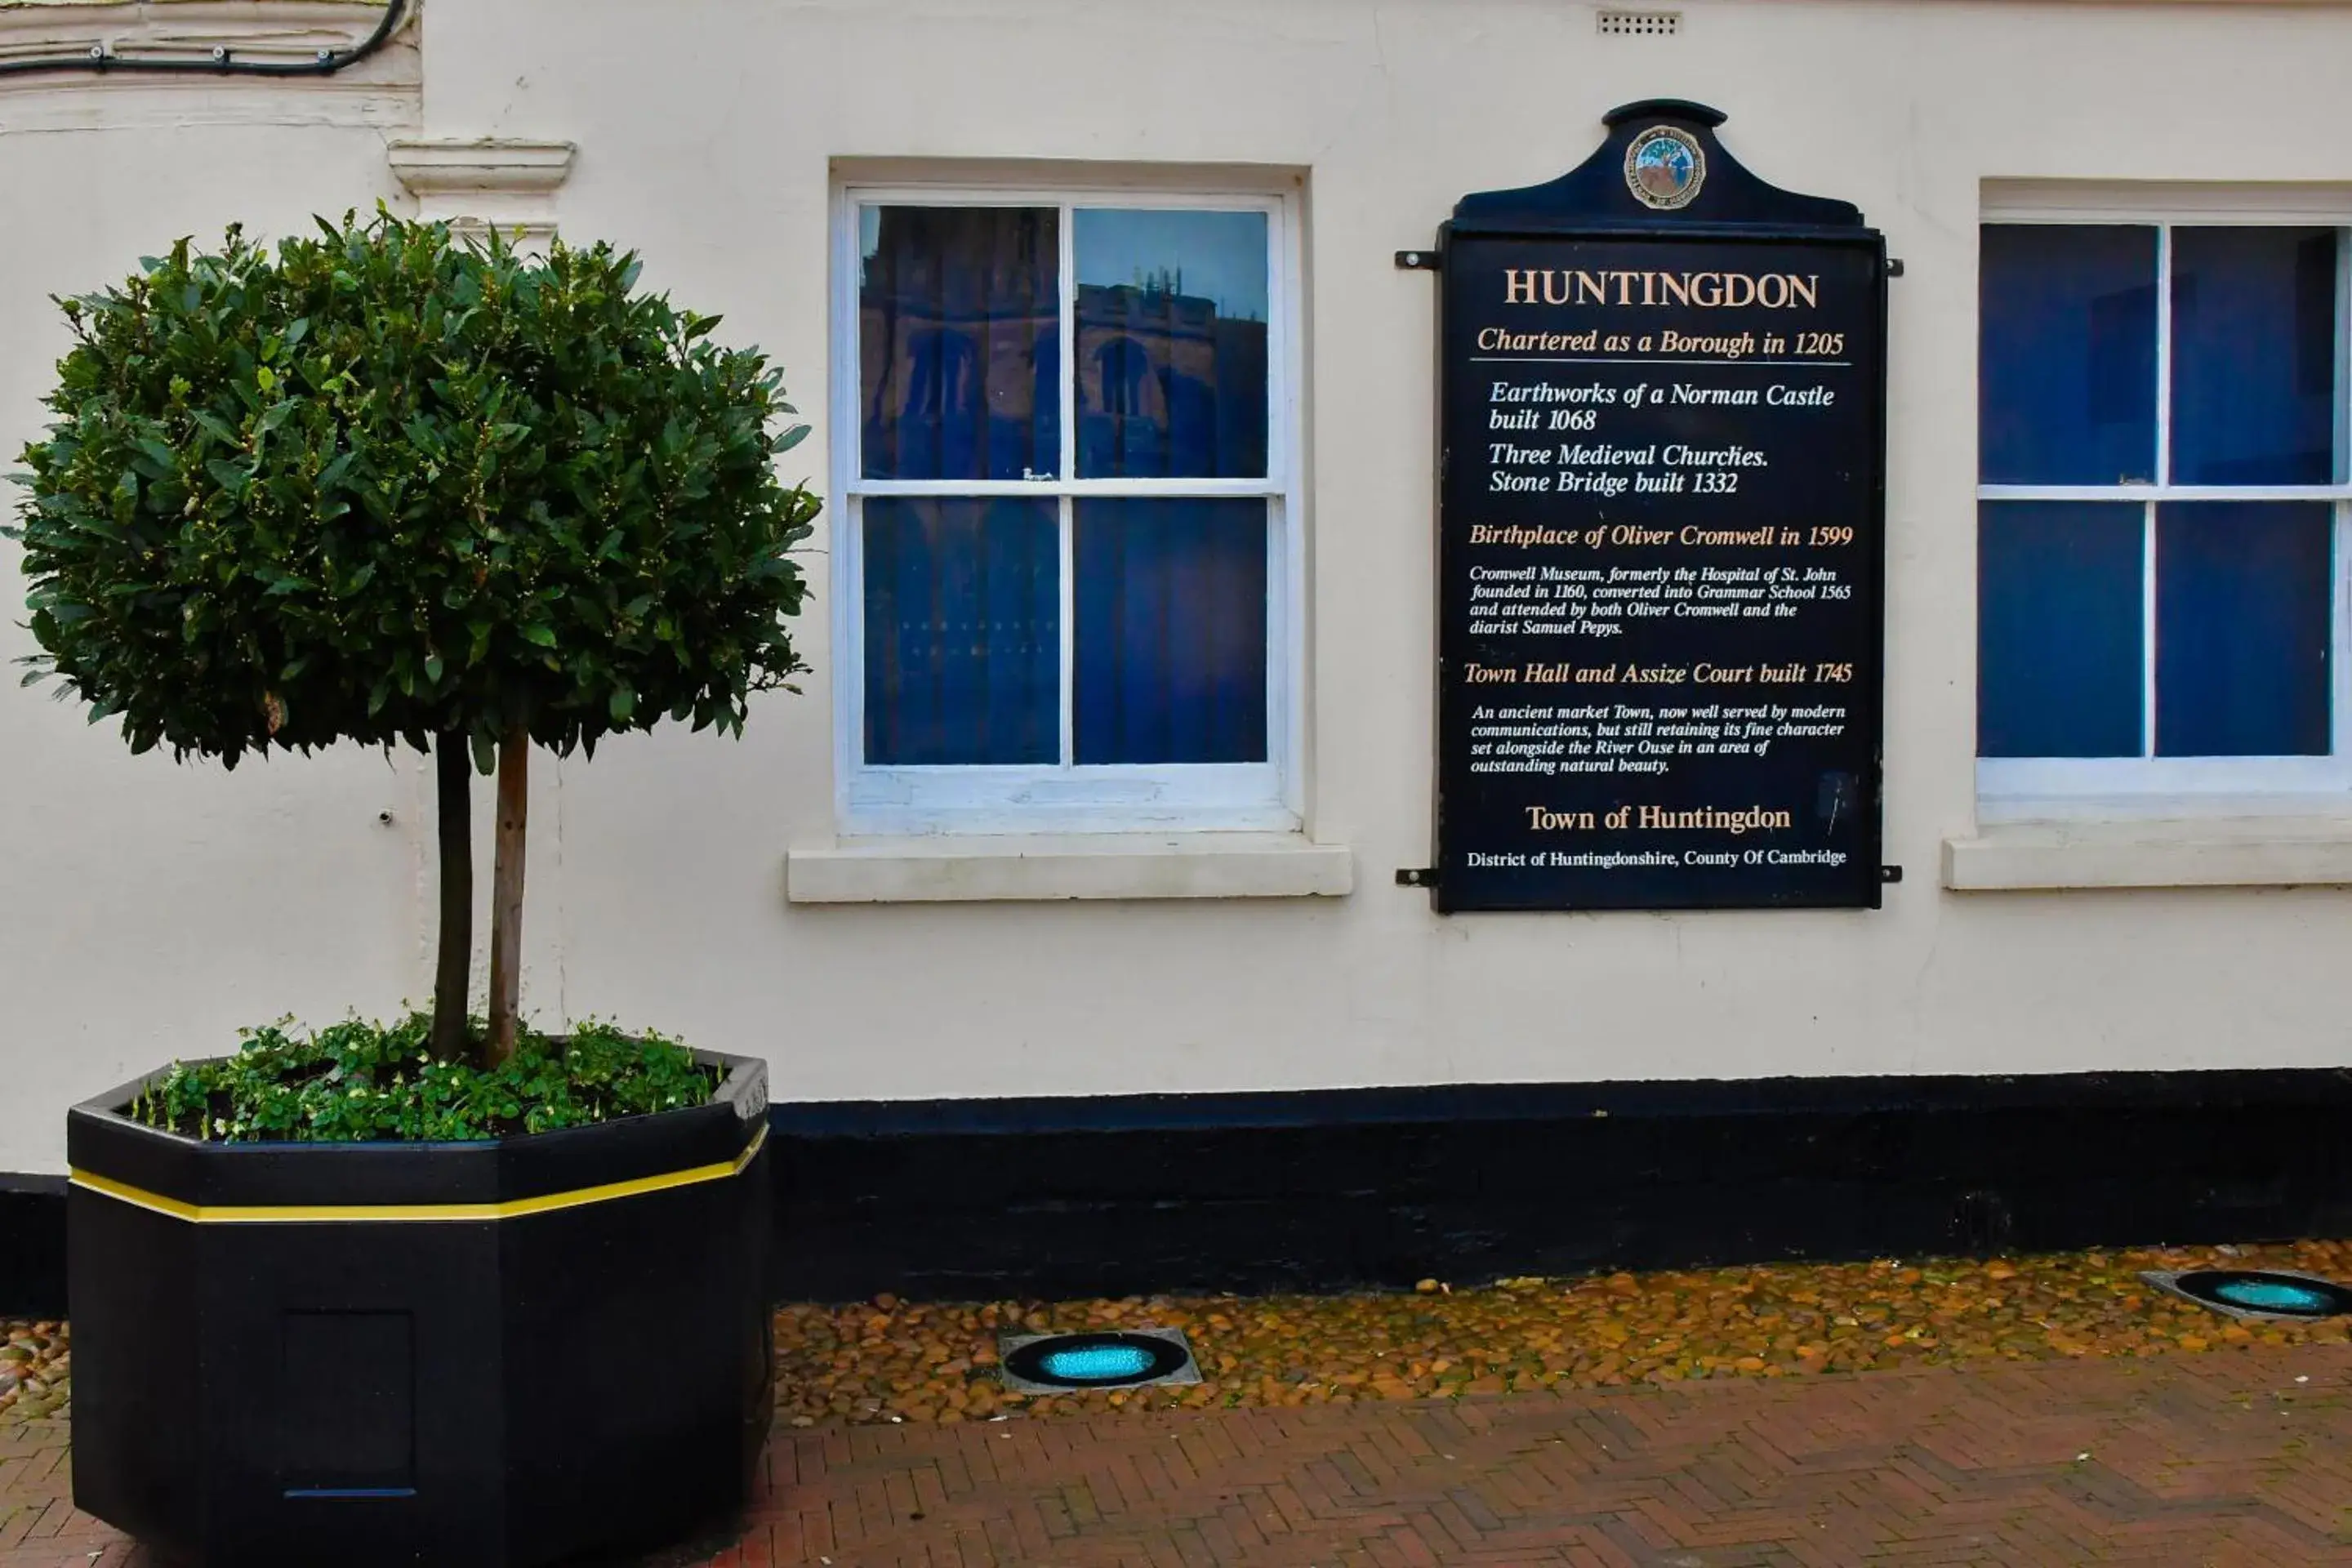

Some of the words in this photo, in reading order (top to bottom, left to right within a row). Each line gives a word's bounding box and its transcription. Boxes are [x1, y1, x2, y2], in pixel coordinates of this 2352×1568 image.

[1504, 270, 1819, 308] HUNTINGDON
[1478, 327, 1597, 351] Chartered
[1604, 336, 1631, 351] as
[1637, 336, 1651, 352] a
[1659, 331, 1754, 359] Borough
[1763, 332, 1784, 354] in
[1794, 332, 1844, 354] 1205
[1490, 382, 1617, 403] Earthworks
[1623, 383, 1647, 408] of
[1650, 389, 1664, 403] a
[1670, 384, 1758, 405] Norman
[1766, 385, 1834, 406] Castle
[1490, 409, 1540, 430] built
[1548, 409, 1597, 430] 1068
[1490, 443, 1552, 465] Three
[1557, 444, 1656, 465] Medieval
[1663, 445, 1767, 466] Churches.
[1490, 470, 1550, 492] Stone
[1557, 471, 1628, 497] Bridge
[1634, 471, 1685, 492] built
[1692, 473, 1738, 492] 1332
[1469, 525, 1578, 549] Birthplace
[1585, 525, 1607, 549] of
[1612, 525, 1673, 545] Oliver
[1681, 526, 1774, 545] Cromwell
[1780, 527, 1799, 545] in
[1809, 527, 1853, 546] 1599
[1470, 566, 1536, 581] Cromwell
[1539, 567, 1604, 582] Museum,
[1607, 567, 1670, 584] formerly
[1674, 568, 1697, 582] the
[1700, 567, 1760, 584] Hospital
[1764, 568, 1779, 584] of
[1781, 568, 1799, 581] St.
[1803, 568, 1836, 581] John
[1470, 584, 1530, 601] founded
[1535, 585, 1548, 598] in
[1554, 585, 1588, 600] 1160,
[1592, 585, 1661, 598] converted
[1664, 585, 1692, 599] into
[1697, 585, 1766, 599] Grammar
[1769, 585, 1816, 599] School
[1820, 586, 1851, 599] 1565
[1470, 602, 1499, 616] and
[1502, 602, 1566, 617] attended
[1570, 602, 1587, 620] by
[1591, 602, 1622, 617] both
[1627, 602, 1670, 617] Oliver
[1674, 602, 1740, 617] Cromwell
[1743, 603, 1771, 617] and
[1775, 603, 1797, 617] the
[1469, 620, 1518, 634] diarist
[1522, 620, 1576, 634] Samuel
[1579, 621, 1622, 637] Pepys.
[1465, 664, 1517, 682] Town
[1524, 664, 1570, 683] Hall
[1575, 664, 1615, 682] and
[1621, 663, 1686, 684] Assize
[1693, 663, 1753, 683] Court
[1760, 663, 1806, 682] built
[1815, 664, 1852, 682] 1745
[1472, 706, 1494, 719] An
[1499, 705, 1553, 719] ancient
[1557, 705, 1609, 719] market
[1614, 705, 1653, 720] Town,
[1659, 708, 1687, 719] now
[1692, 705, 1719, 719] well
[1722, 704, 1767, 719] served
[1771, 704, 1787, 721] by
[1791, 704, 1845, 718] modern
[1471, 723, 1592, 738] communications,
[1597, 723, 1620, 736] but
[1624, 723, 1653, 736] still
[1656, 723, 1720, 739] retaining
[1724, 723, 1741, 736] its
[1742, 722, 1773, 739] fine
[1776, 722, 1844, 736] character
[1471, 742, 1492, 755] set
[1496, 740, 1565, 758] alongside
[1568, 740, 1592, 755] the
[1595, 740, 1634, 754] River
[1638, 740, 1674, 754] Ouse
[1678, 740, 1692, 753] in
[1696, 743, 1714, 753] an
[1718, 743, 1750, 753] area
[1754, 740, 1768, 756] of
[1471, 759, 1556, 775] outstanding
[1560, 758, 1614, 772] natural
[1618, 758, 1668, 775] beauty.
[1526, 807, 1594, 830] Town
[1605, 806, 1631, 829] of
[1639, 805, 1790, 834] Huntingdon
[1468, 853, 1526, 866] District
[1530, 852, 1547, 866] of
[1550, 851, 1679, 869] Huntingdonshire,
[1684, 851, 1740, 867] County
[1744, 850, 1764, 864] Of
[1767, 849, 1846, 866] Cambridge
